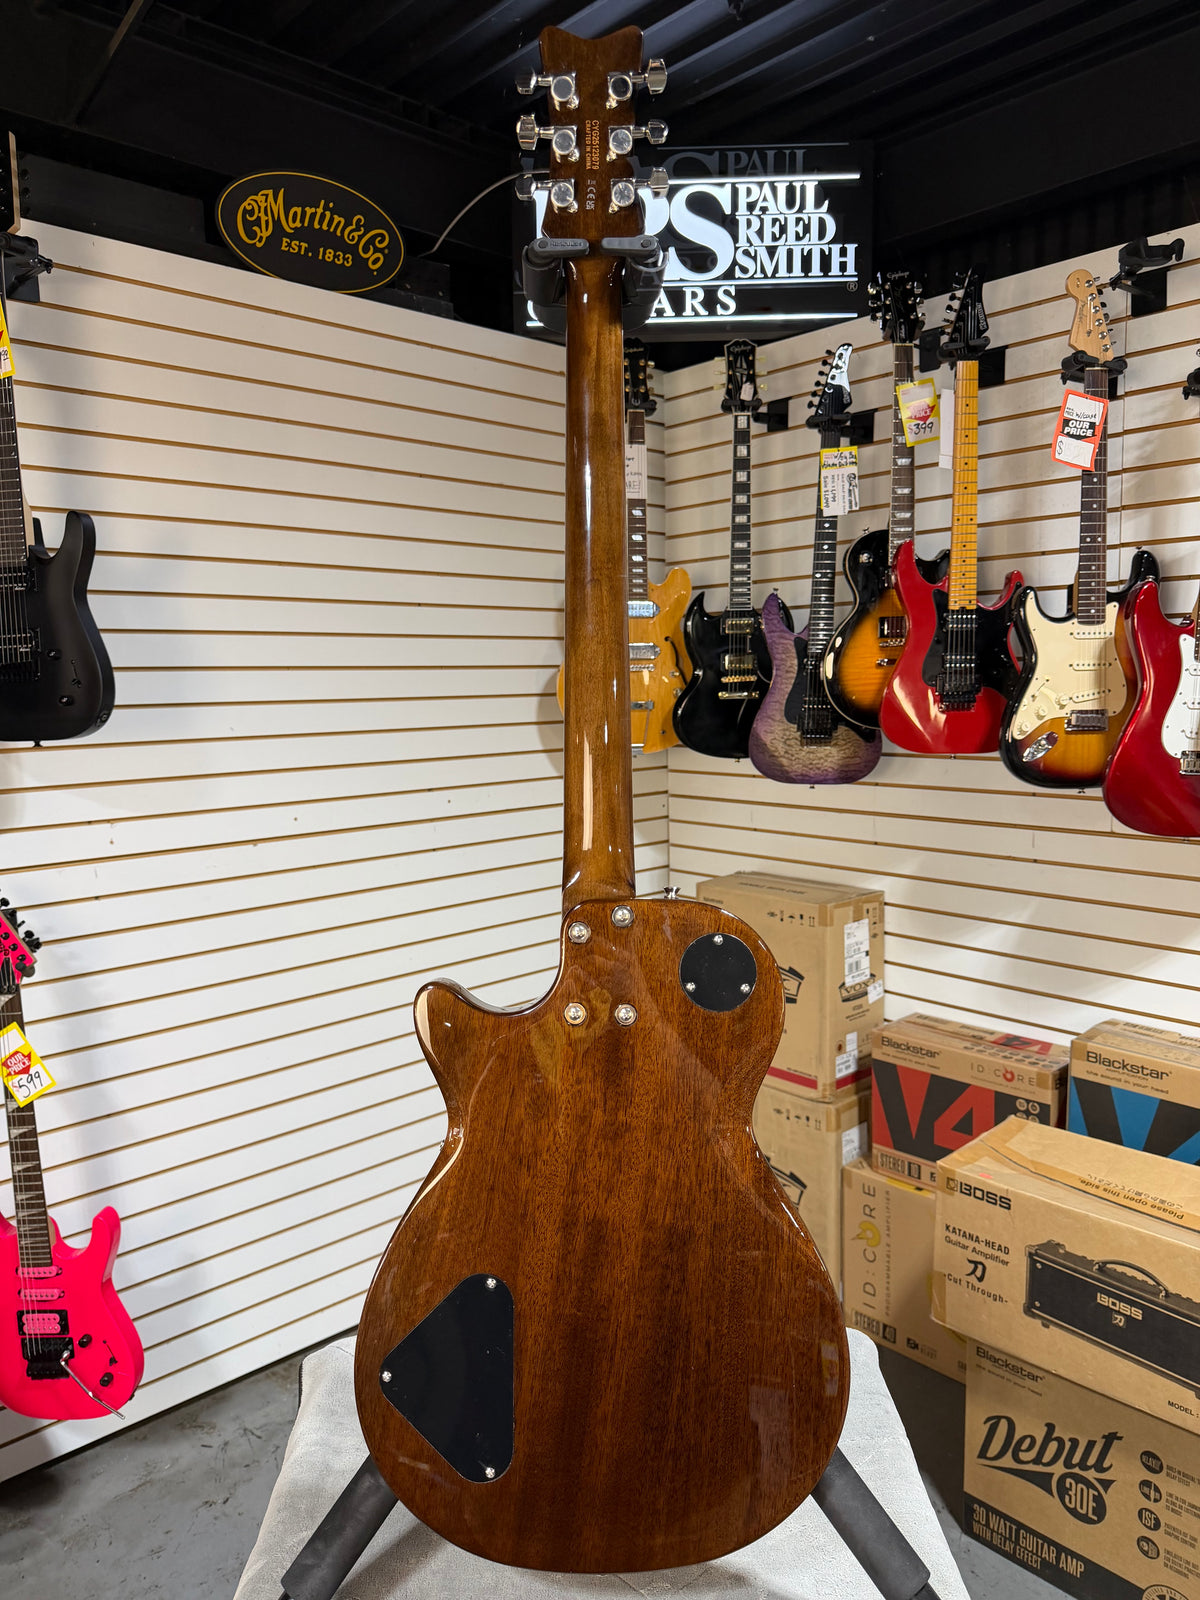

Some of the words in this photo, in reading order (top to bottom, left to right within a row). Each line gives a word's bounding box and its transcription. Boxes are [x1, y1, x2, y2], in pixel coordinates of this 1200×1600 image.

[735, 181, 829, 215] PAUL
[735, 213, 837, 247] REED
[281, 237, 312, 257] EST.
[318, 247, 353, 267] 1833
[735, 244, 859, 279] SMITH
[1063, 427, 1093, 437] PRICE
[1069, 420, 1090, 429] OUR
[8, 1053, 25, 1066] OUR
[881, 1036, 940, 1059] Blackstar
[9, 1058, 31, 1075] PRICE
[1086, 1050, 1170, 1081] Blackstar
[880, 1152, 906, 1174] STEREO
[959, 1181, 1011, 1211] BOSS
[1079, 1177, 1100, 1190] side.
[1102, 1186, 1121, 1198] this
[1123, 1193, 1148, 1207] open
[1150, 1203, 1185, 1220] Please
[944, 1223, 1010, 1256] KATANA-HEAD
[944, 1235, 970, 1251] Guitar
[971, 1246, 1010, 1267] Amplifier
[1096, 1292, 1143, 1321] BOSS
[854, 1310, 881, 1337] STEREO
[976, 1346, 1043, 1383] Blackstar
[1167, 1400, 1195, 1417] MODEL
[976, 1415, 1124, 1474] Debut
[1064, 1477, 1099, 1522] 30E
[1141, 1509, 1157, 1529] ISF
[972, 1520, 991, 1542] WITH
[992, 1532, 1014, 1555] DELAY
[1015, 1545, 1042, 1571] EFFECT
[973, 1503, 986, 1525] 30
[988, 1511, 1017, 1542] WATT
[1019, 1529, 1057, 1566] GUITAR
[1059, 1552, 1085, 1579] AMP
